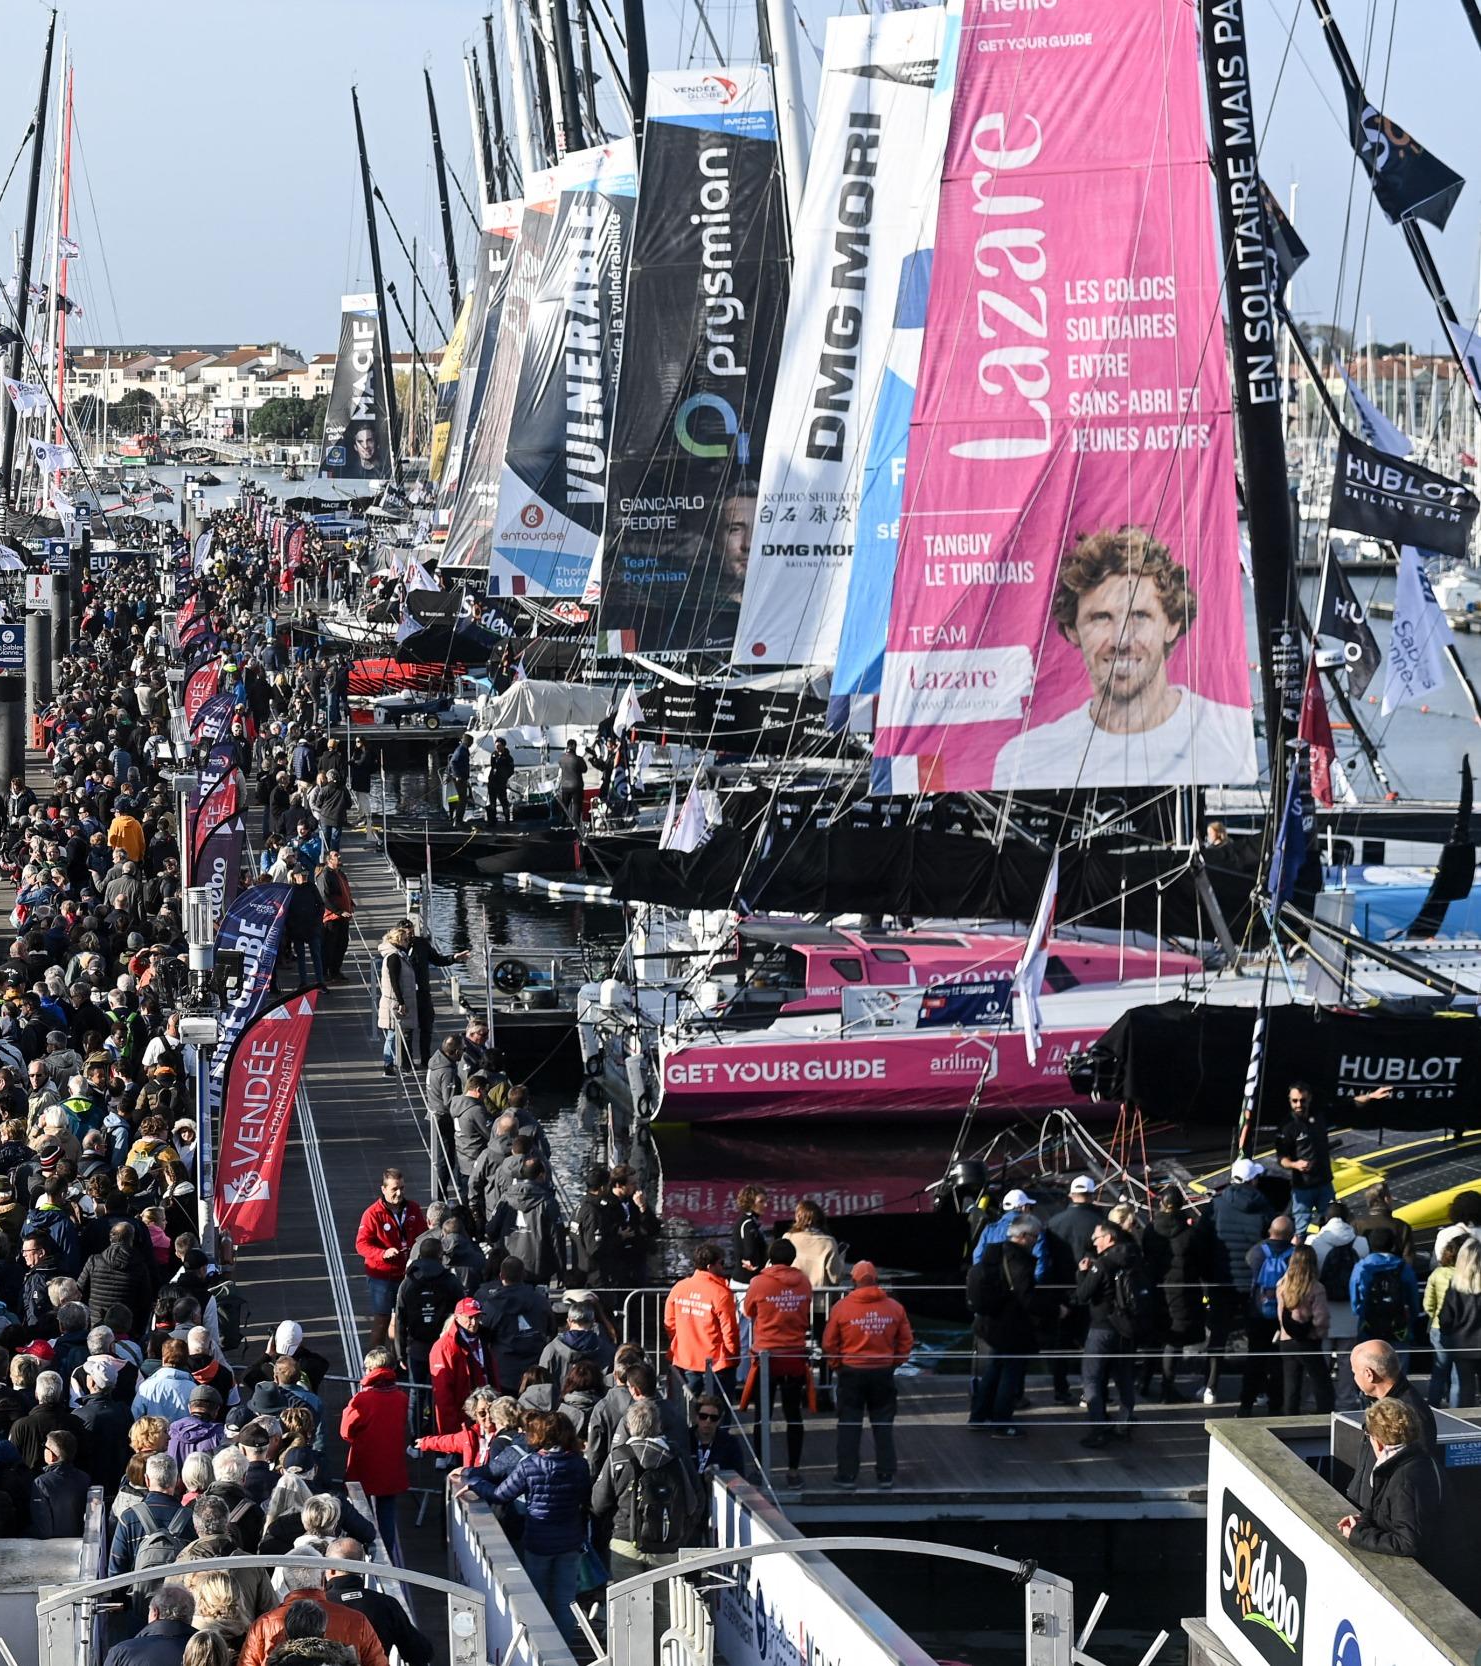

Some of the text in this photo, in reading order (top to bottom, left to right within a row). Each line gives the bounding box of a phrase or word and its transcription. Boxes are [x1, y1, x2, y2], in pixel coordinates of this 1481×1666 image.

[978, 33, 1093, 52] GET YOUR GUIDE
[673, 85, 718, 93] VENDÉE
[723, 117, 767, 125] IMOCA
[1212, 0, 1278, 404] EN SOLITAIRE MAIS PA
[690, 147, 747, 377] prysmian
[805, 112, 882, 463] DMG MORI
[949, 111, 1052, 459] Lazare
[1065, 275, 1176, 306] LES COLOCS
[1066, 313, 1177, 342] SOLIDAIRES
[351, 321, 376, 420] MACIF
[1067, 354, 1129, 380] ENTRE
[1068, 386, 1201, 416] SANS-ABRI ET
[1069, 424, 1210, 453] JEUNES ACTIFS
[1346, 453, 1467, 506] HUBLOT
[619, 495, 705, 512] GIANCARLO
[1414, 505, 1461, 523] TEAM
[621, 516, 677, 531] PEDOTE
[761, 545, 808, 557] DMG
[924, 534, 992, 557] TANGUY
[622, 557, 658, 568] Team
[925, 561, 1035, 587] LE TURQUAIS
[623, 571, 688, 584] Prysmian
[3, 643, 24, 651] Sables
[909, 626, 967, 645] TEAM
[910, 665, 997, 690] Lazare
[667, 1058, 887, 1085] GET YOUR GUIDE
[930, 1054, 984, 1070] arilim
[1338, 1054, 1462, 1082] HUBLOT
[230, 1039, 279, 1168] VENDÉE
[1222, 1512, 1300, 1652] Sodebo
